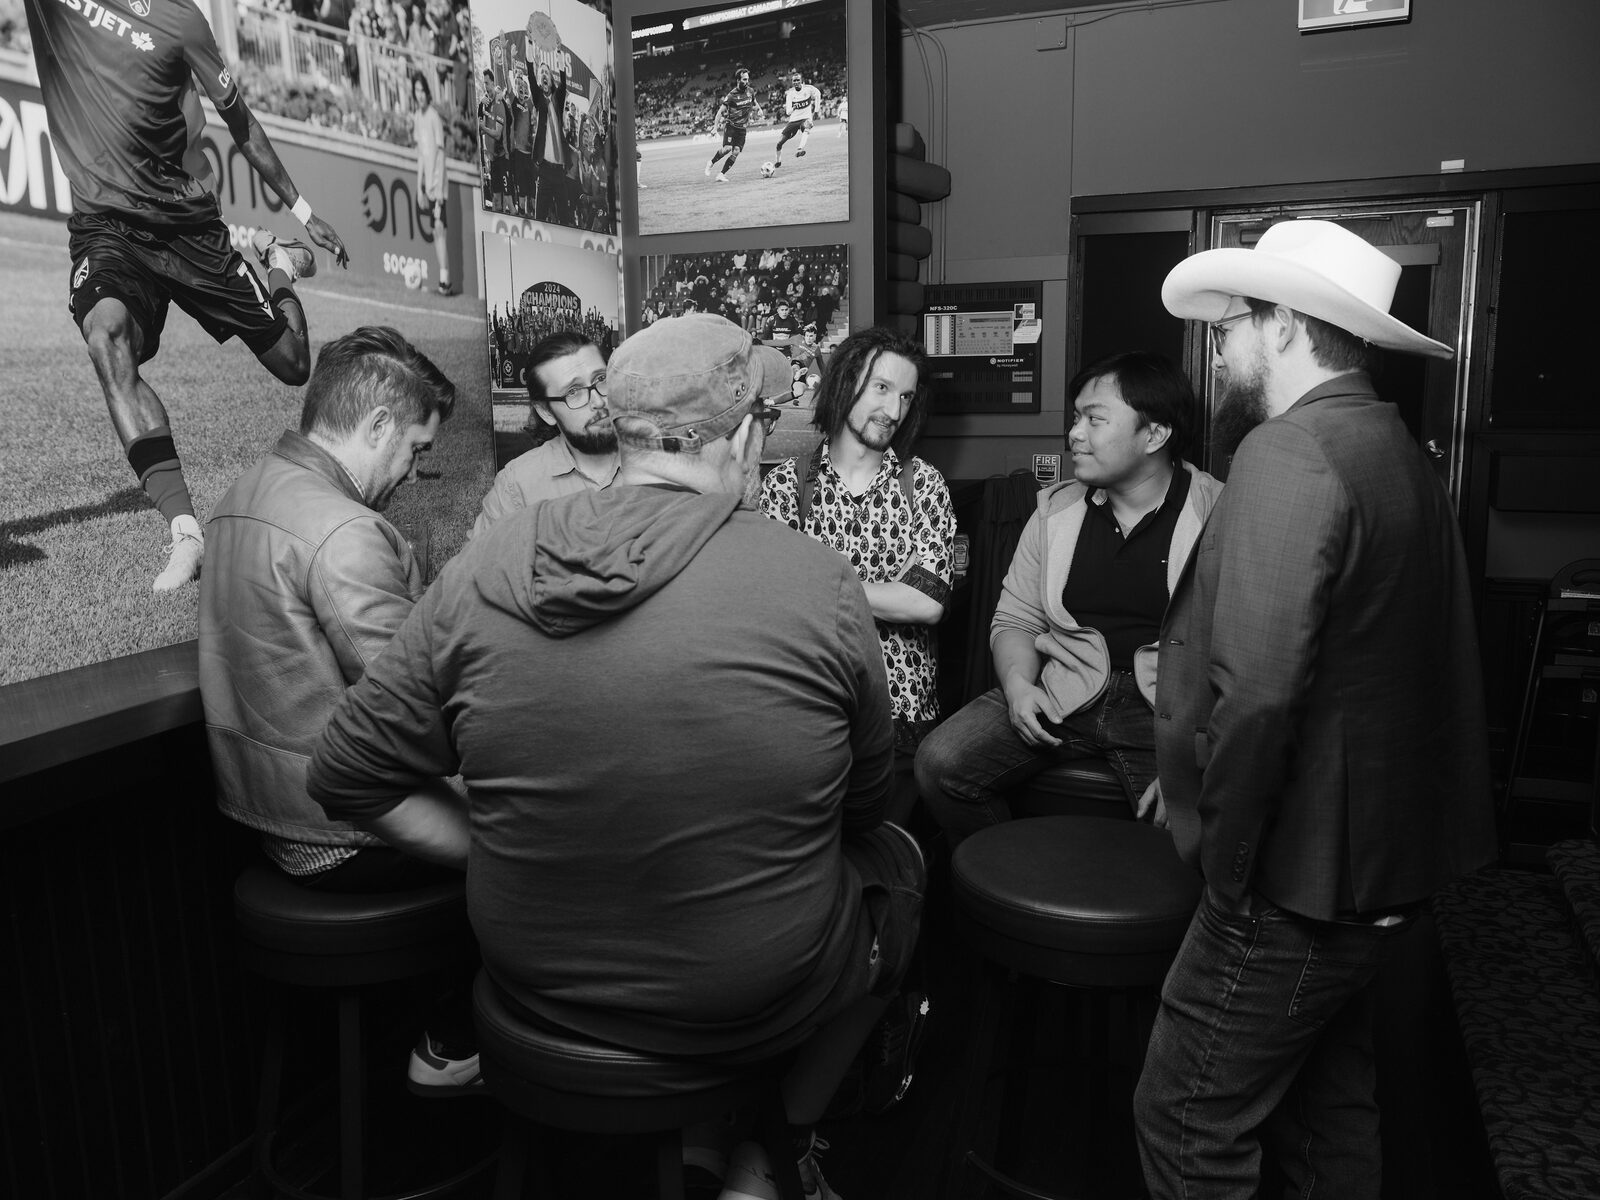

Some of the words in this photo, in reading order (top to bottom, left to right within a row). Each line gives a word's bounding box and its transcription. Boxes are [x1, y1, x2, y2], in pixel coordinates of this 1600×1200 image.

[58, 0, 132, 37] STJET
[544, 283, 560, 293] 2024
[526, 291, 578, 310] CHAMPIONS
[1035, 456, 1057, 465] FIRE
